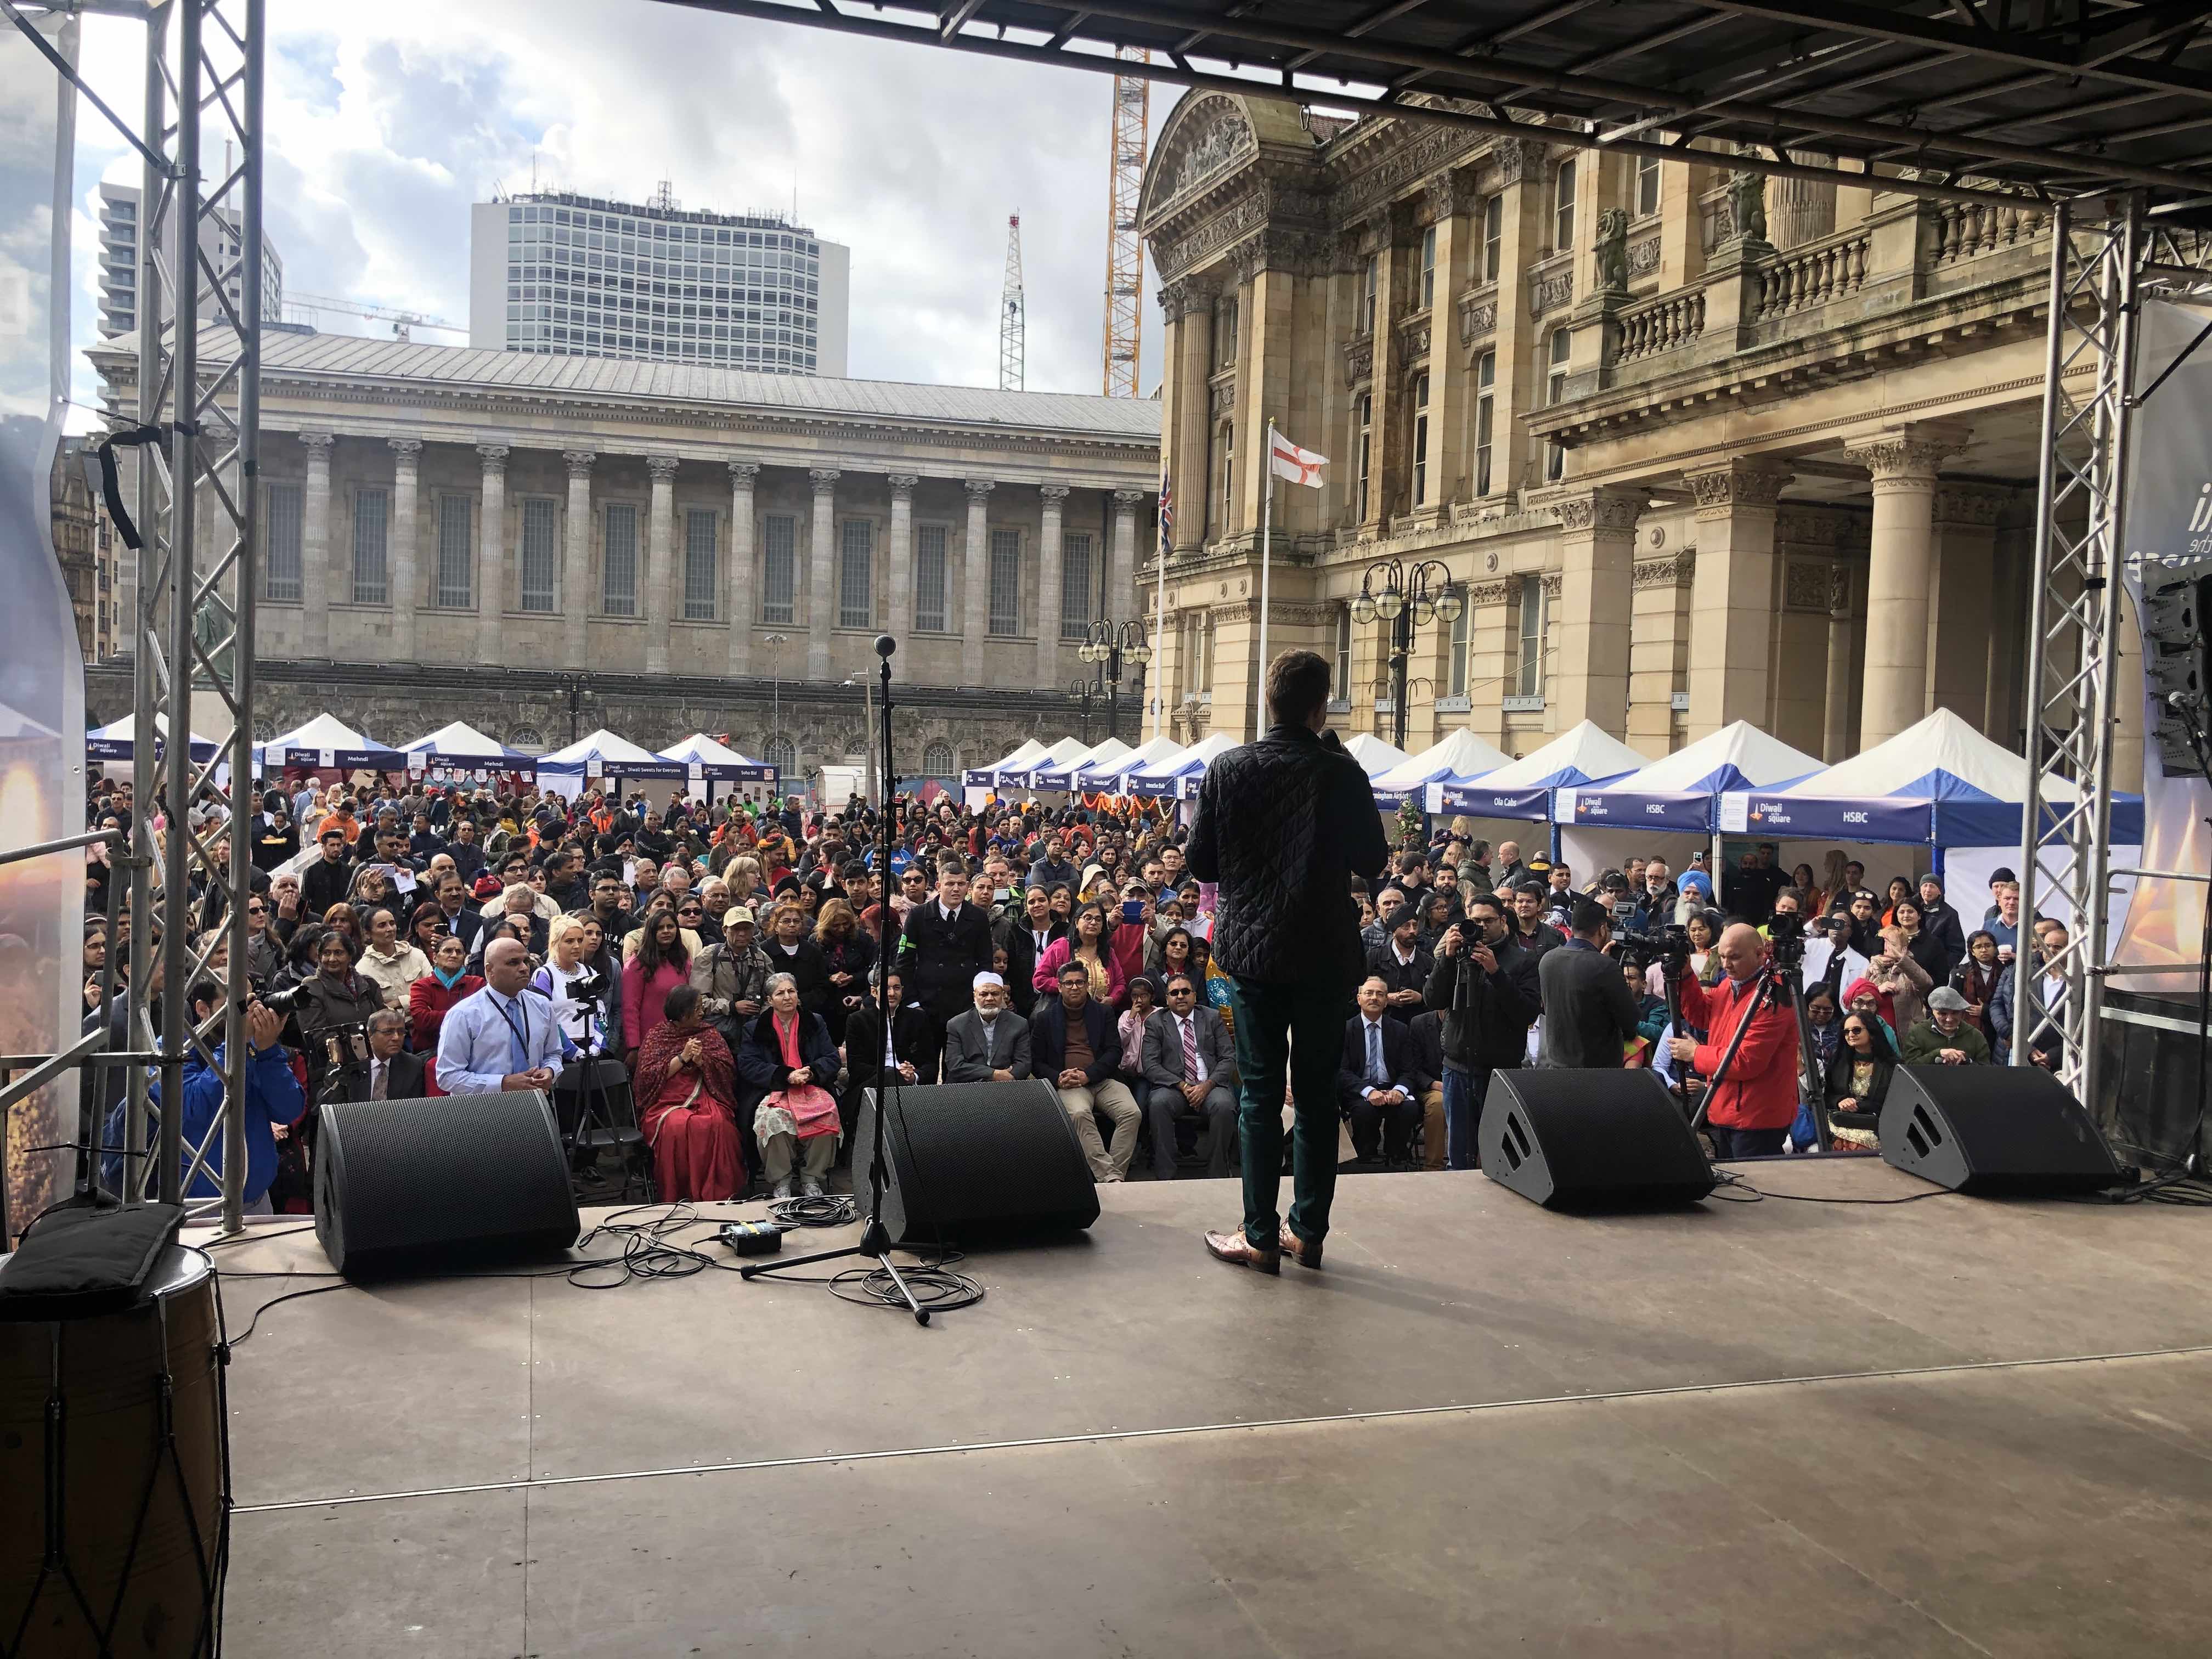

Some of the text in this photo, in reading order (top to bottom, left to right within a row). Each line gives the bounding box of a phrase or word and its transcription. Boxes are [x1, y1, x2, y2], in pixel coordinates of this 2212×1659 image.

[1393, 792, 1409, 800] Airport
[1494, 797, 1517, 806] Ola Cabs
[1585, 797, 1602, 806] Diwali
[1646, 804, 1665, 814] HSBC
[1760, 803, 1782, 812] Diwali
[1768, 815, 1791, 824] square
[1843, 811, 1869, 823] HSBC
